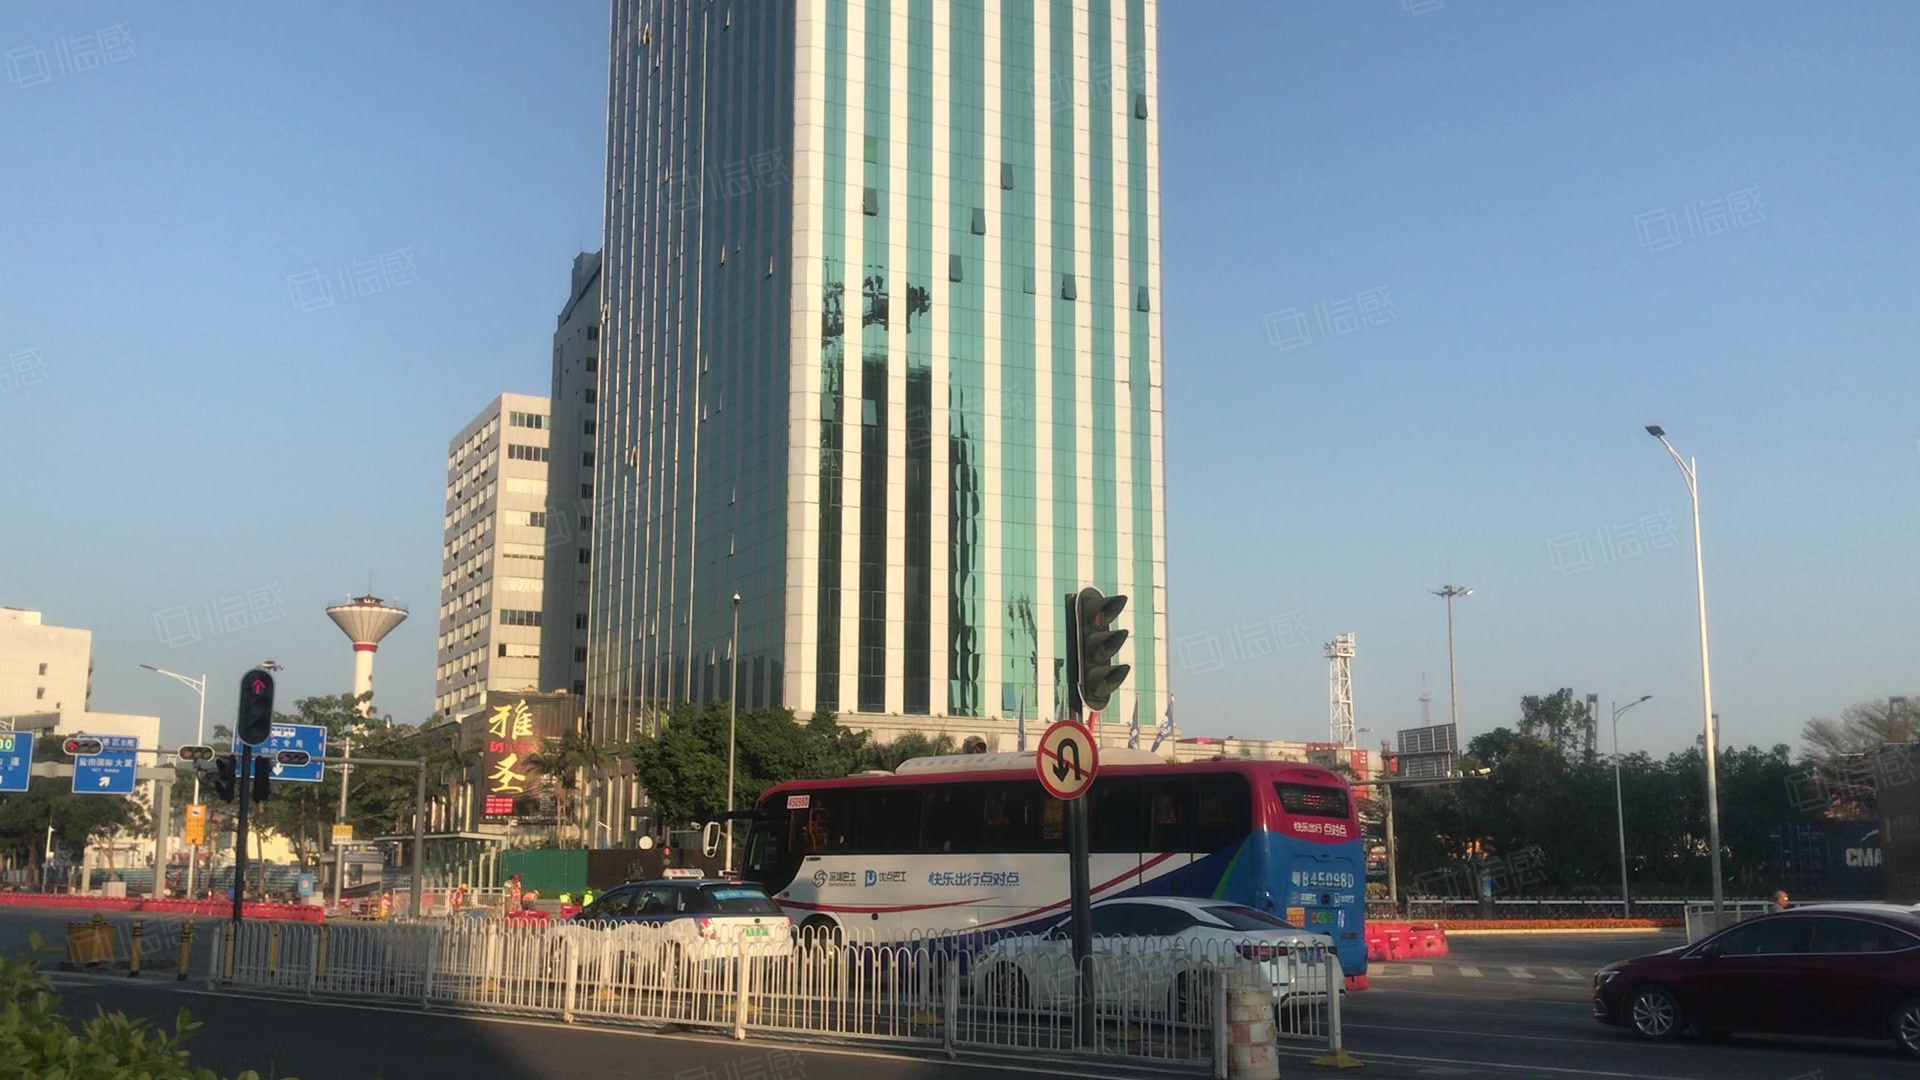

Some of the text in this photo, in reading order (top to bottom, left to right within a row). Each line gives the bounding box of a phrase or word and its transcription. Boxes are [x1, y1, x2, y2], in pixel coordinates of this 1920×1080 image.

[1324, 823, 1348, 837] 点对点
[928, 871, 1020, 887] 快乐出行点对点
